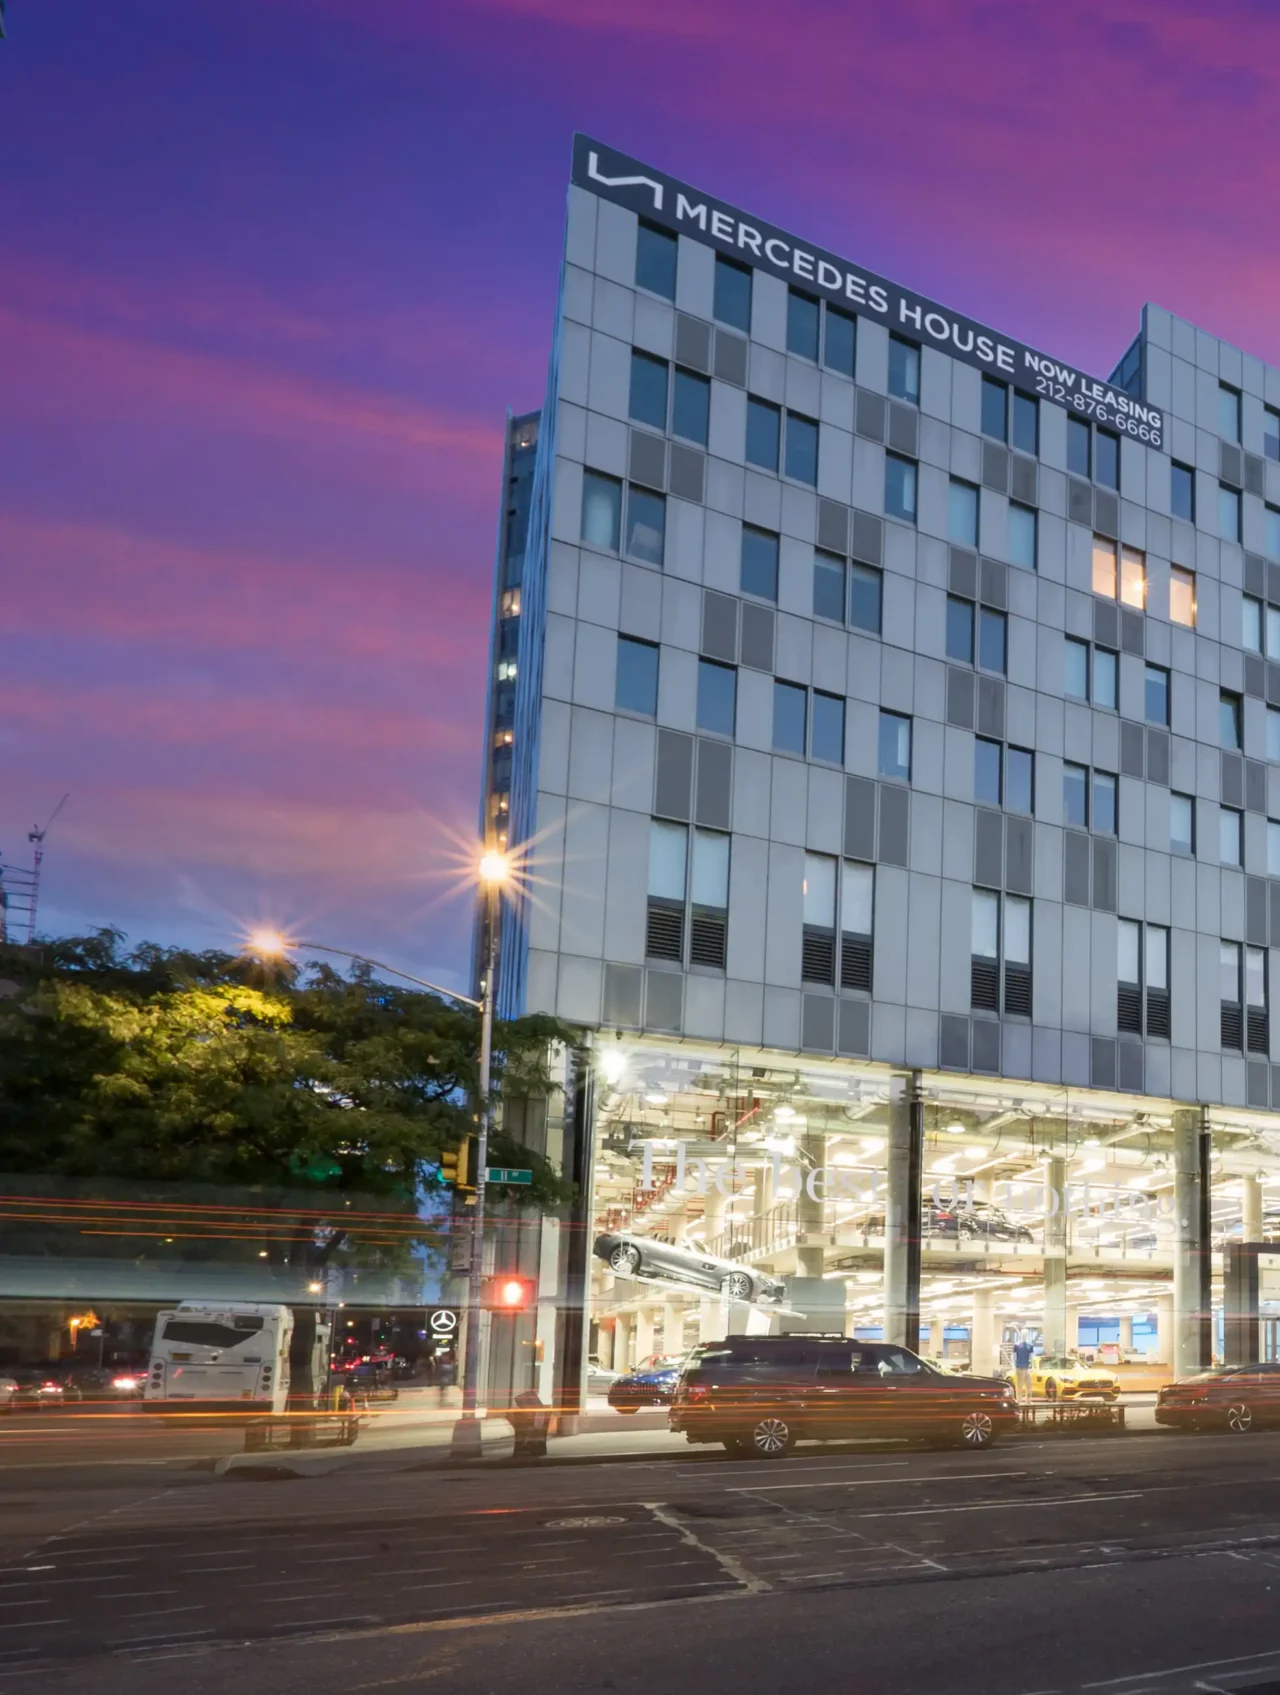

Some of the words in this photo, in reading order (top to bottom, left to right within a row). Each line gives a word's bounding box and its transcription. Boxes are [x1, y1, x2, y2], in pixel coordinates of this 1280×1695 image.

[676, 193, 888, 313] MERCEDES
[900, 298, 1015, 374] HOUSE
[1025, 351, 1076, 387] NOW
[1081, 378, 1161, 429] LEASING
[1035, 376, 1161, 446] 212-876-6666
[627, 1138, 746, 1198] The
